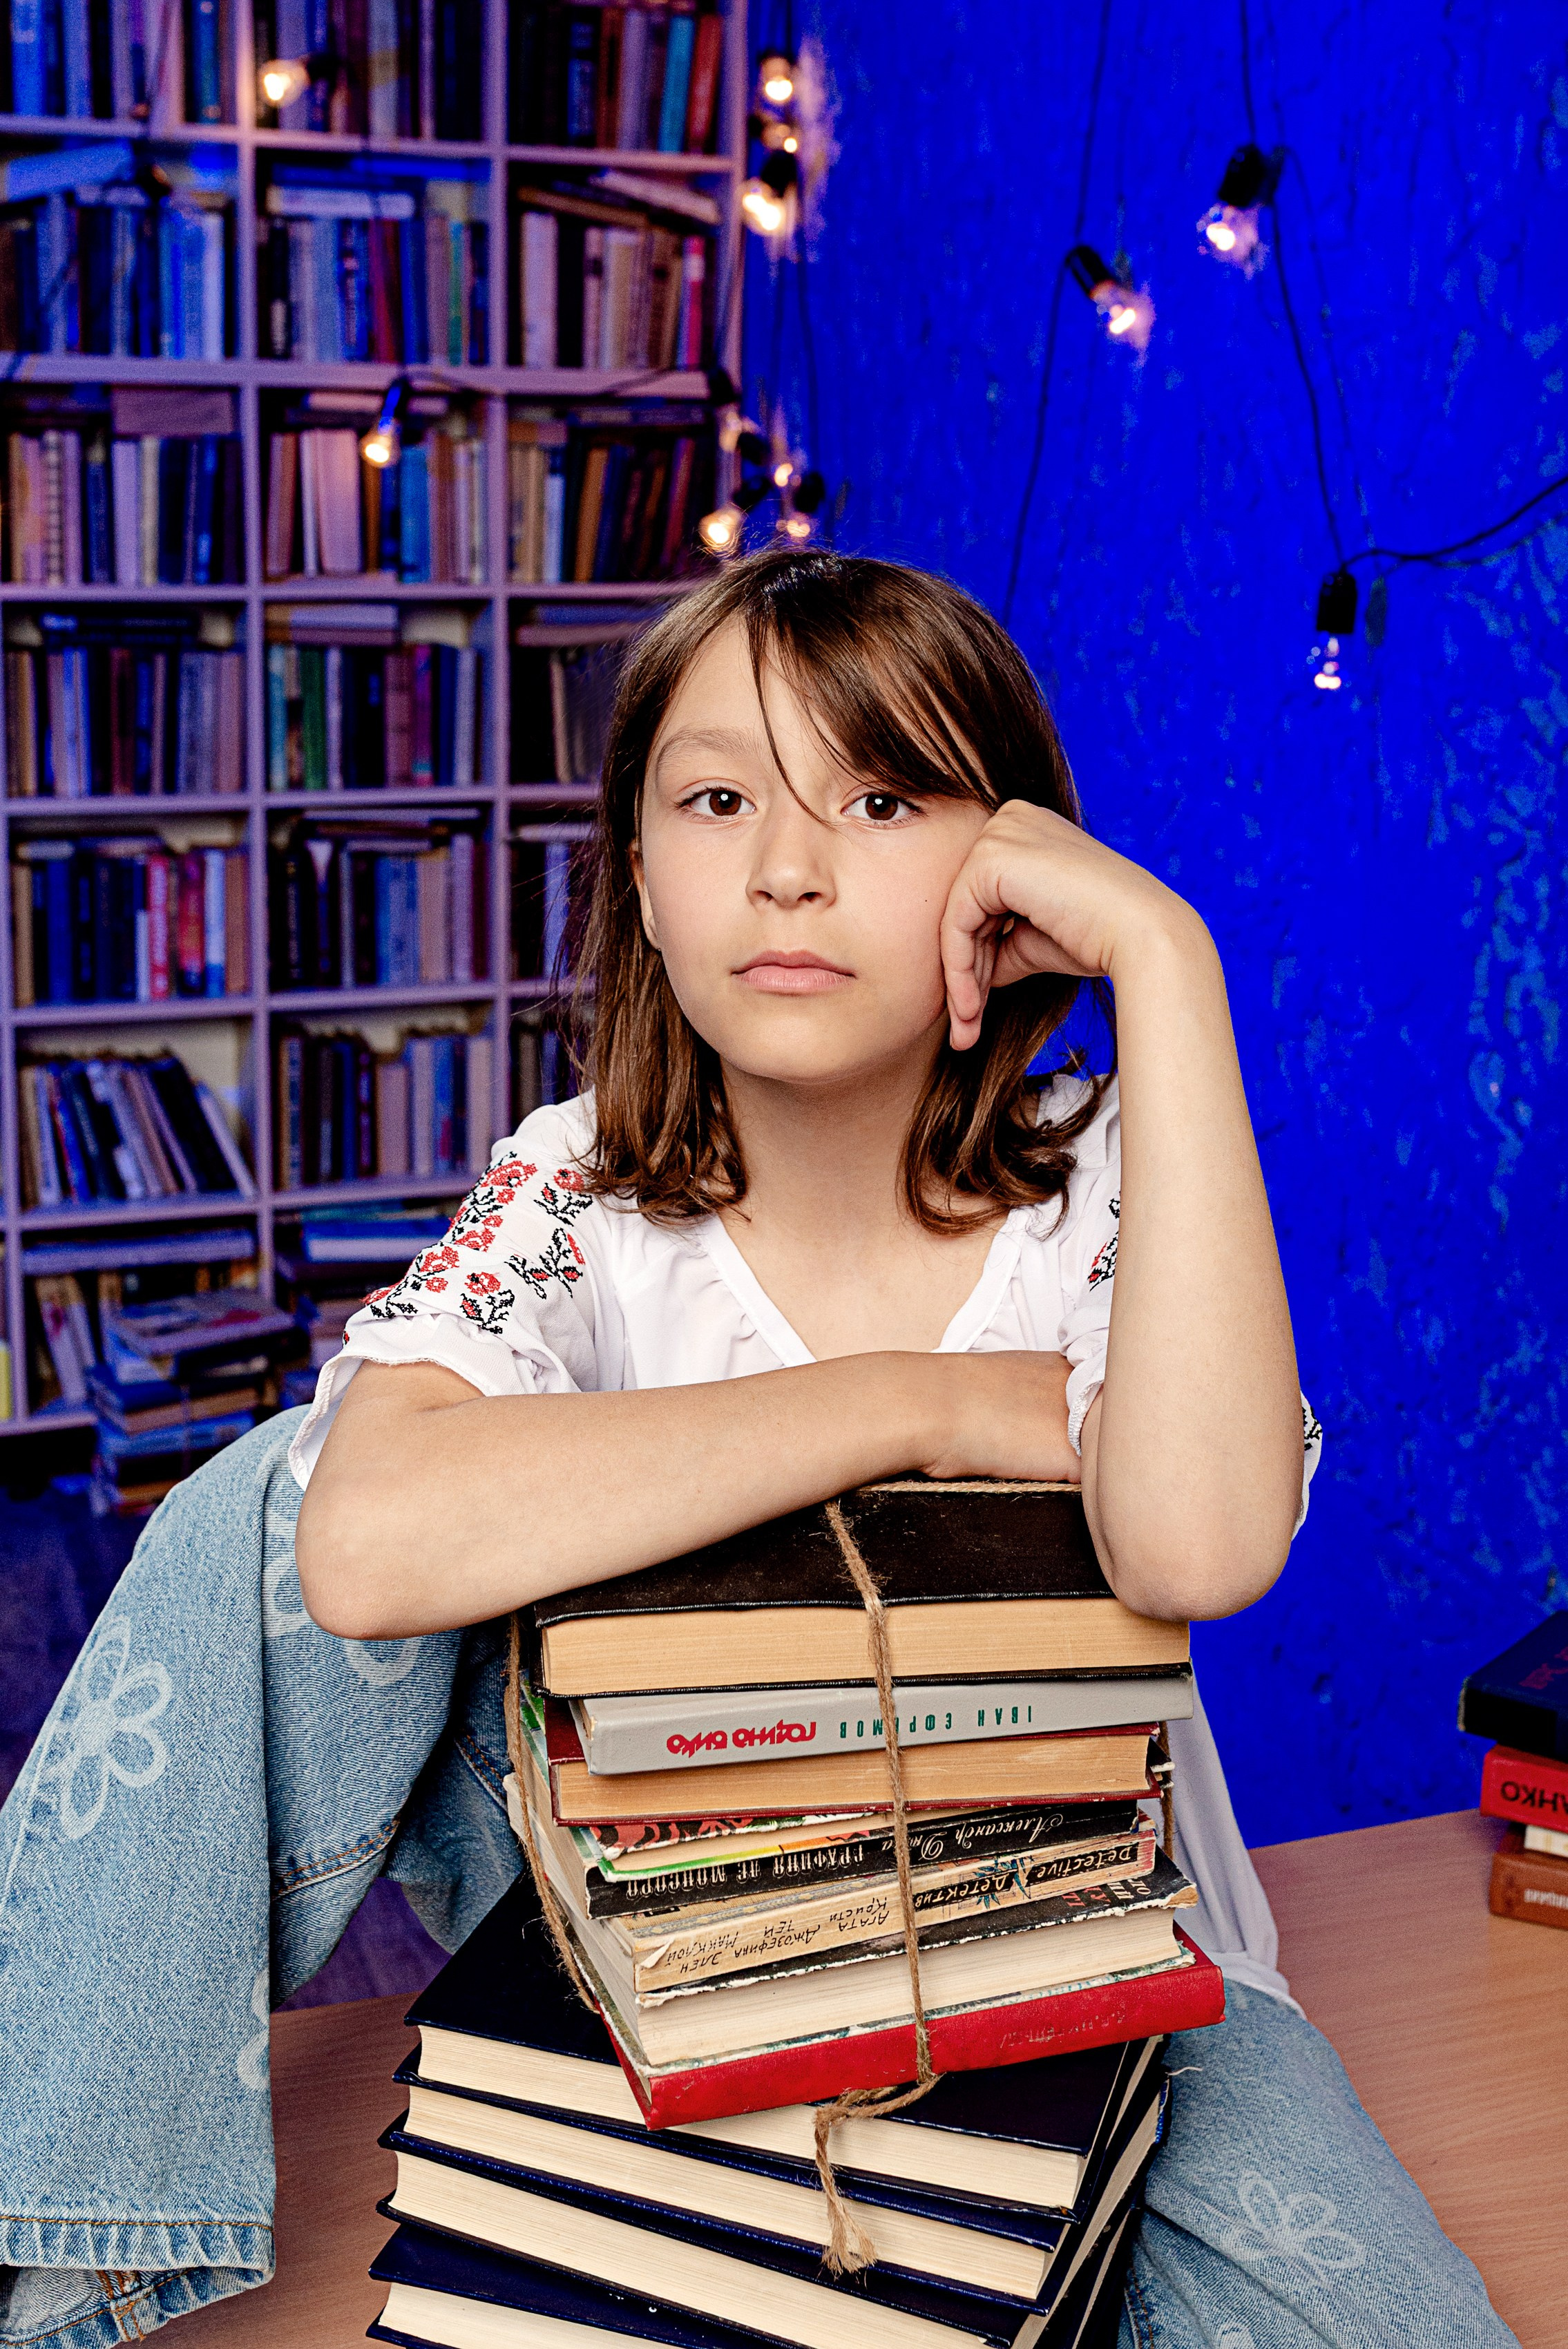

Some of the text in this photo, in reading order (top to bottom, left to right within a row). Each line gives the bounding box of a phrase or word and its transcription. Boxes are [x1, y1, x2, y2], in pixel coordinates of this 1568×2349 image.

[977, 1705, 1031, 1727] ІВАН
[881, 1813, 1064, 1861] Александр Дюа
[626, 1844, 863, 1900] ГРАФИНЯ ДЕ МОНСОРО
[1037, 1845, 1131, 1878] Detective
[830, 1897, 888, 1923] Кристи
[839, 1910, 890, 1932] АГАТА
[763, 1919, 795, 1936] ТЕЙ
[680, 1951, 723, 1974] ЭЛЕН
